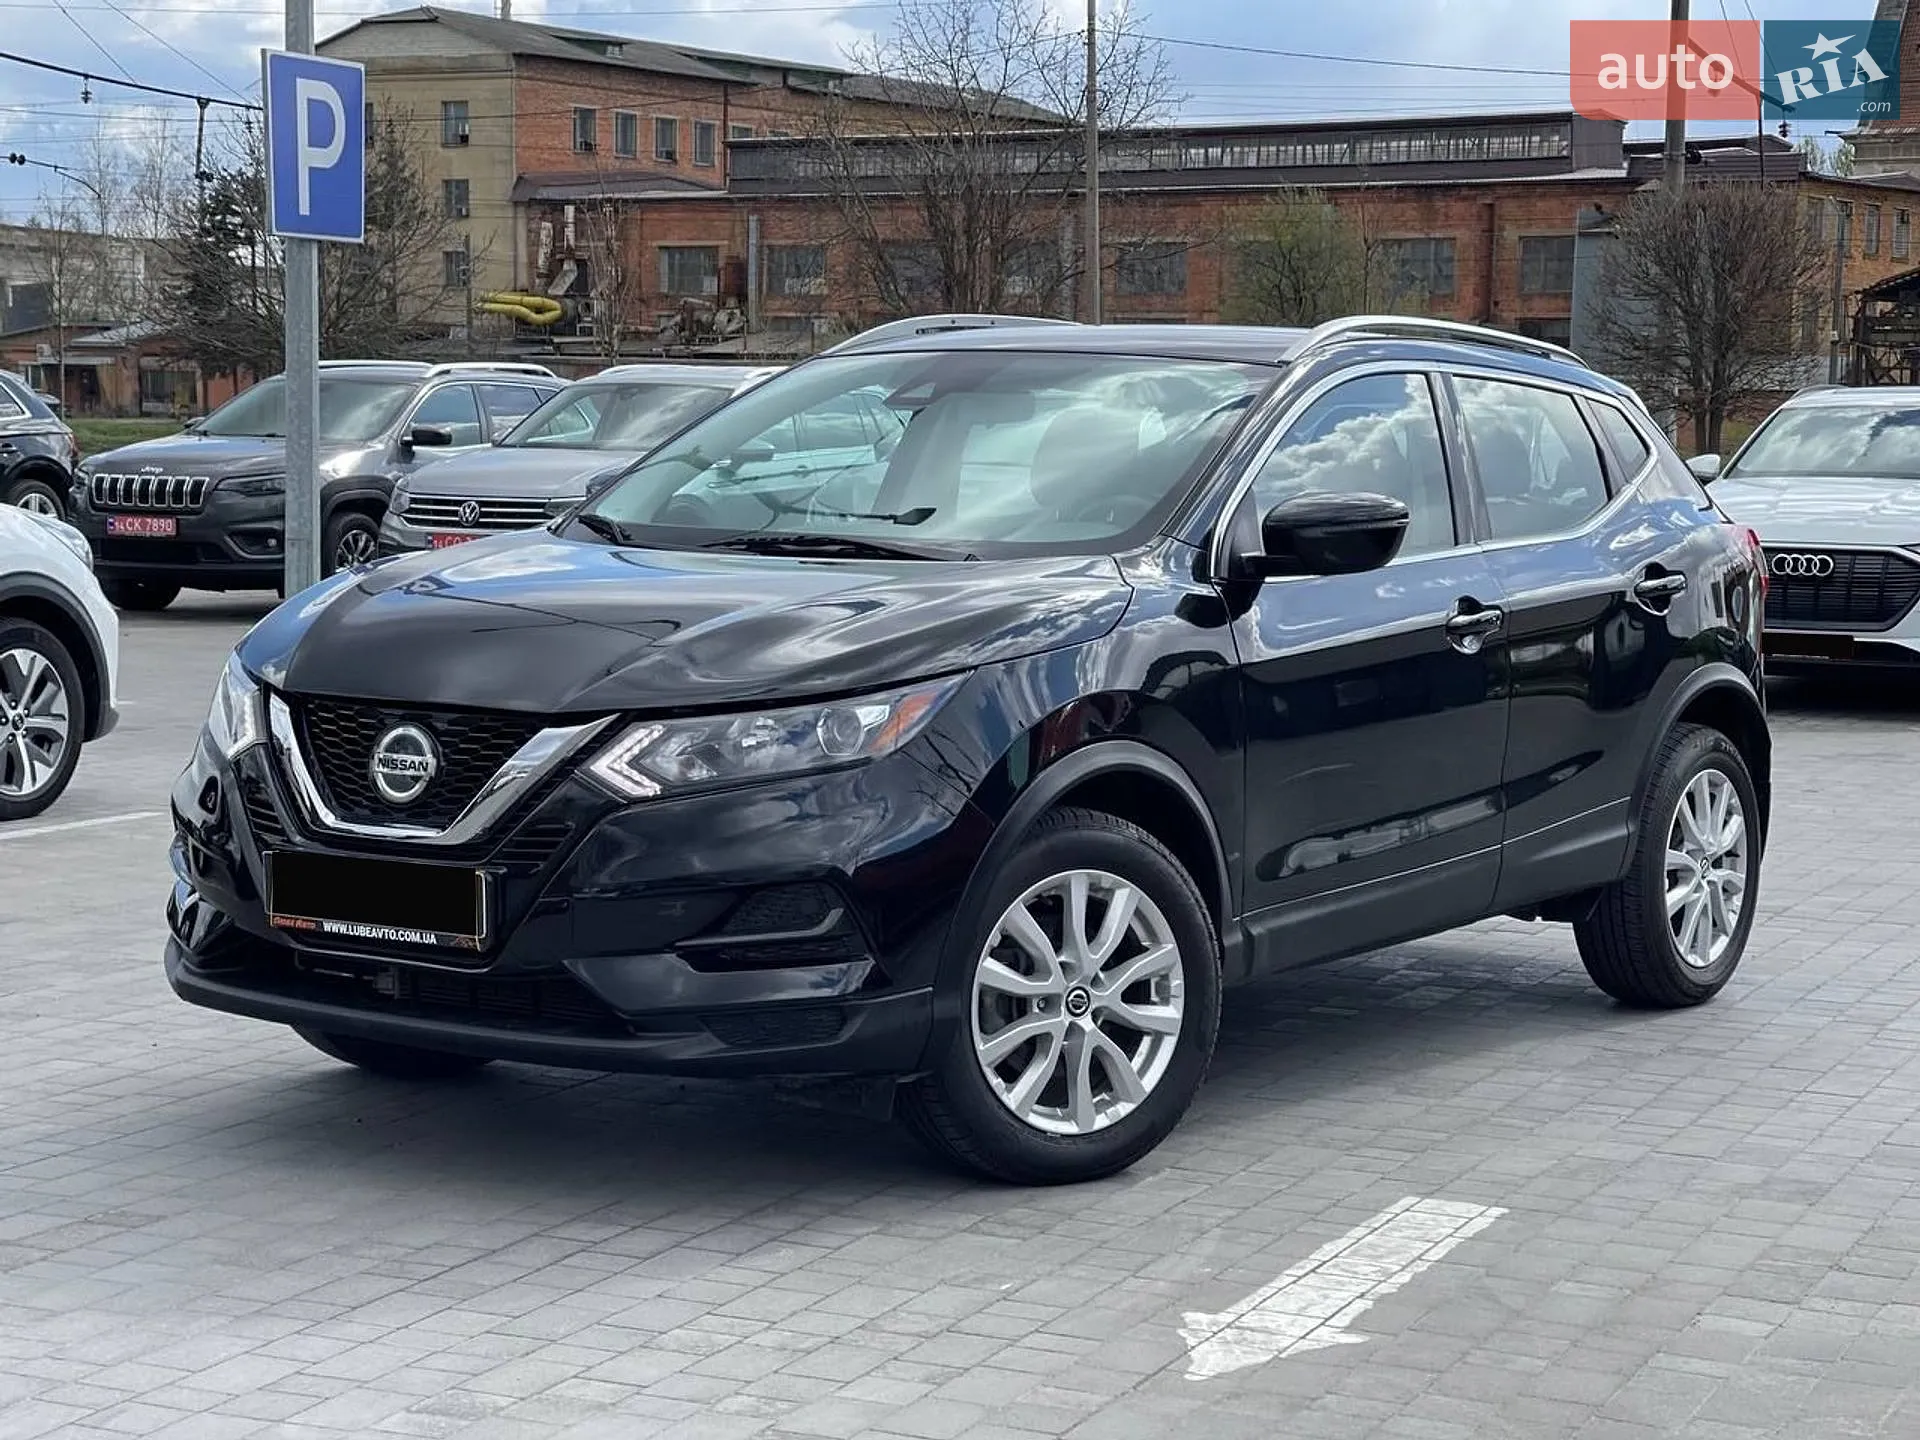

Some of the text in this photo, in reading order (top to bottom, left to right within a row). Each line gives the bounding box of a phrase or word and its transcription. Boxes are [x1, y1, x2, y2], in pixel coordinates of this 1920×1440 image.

[296, 77, 345, 216] P
[376, 757, 429, 772] NISSAN
[322, 922, 437, 945] WWW.LUBEAVTO.COM.UA
